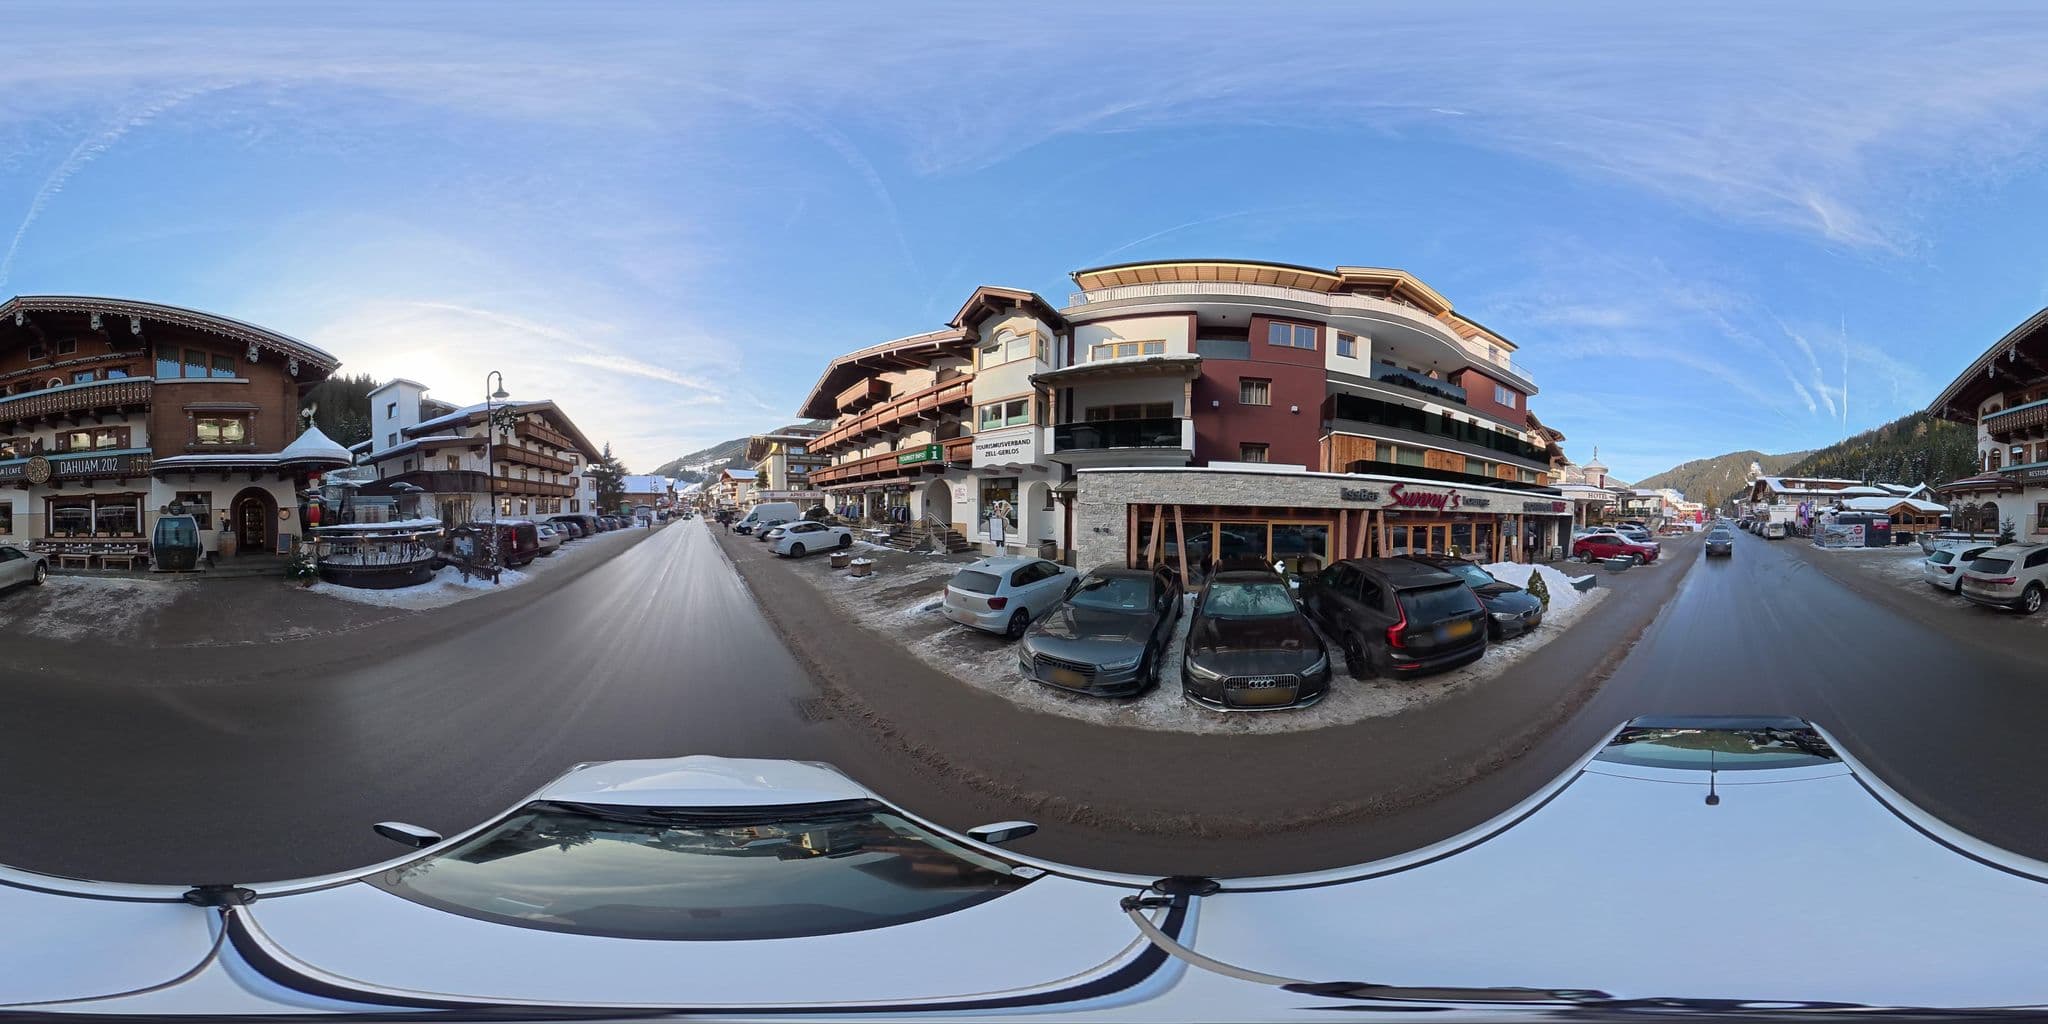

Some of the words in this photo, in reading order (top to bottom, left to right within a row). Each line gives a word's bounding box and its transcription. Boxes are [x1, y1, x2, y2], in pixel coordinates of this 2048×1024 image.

[976, 438, 1031, 451] TOURISMUSVERBAND
[985, 447, 1019, 458] ZELL-GERLOS
[60, 458, 118, 474] DAHUAM.202
